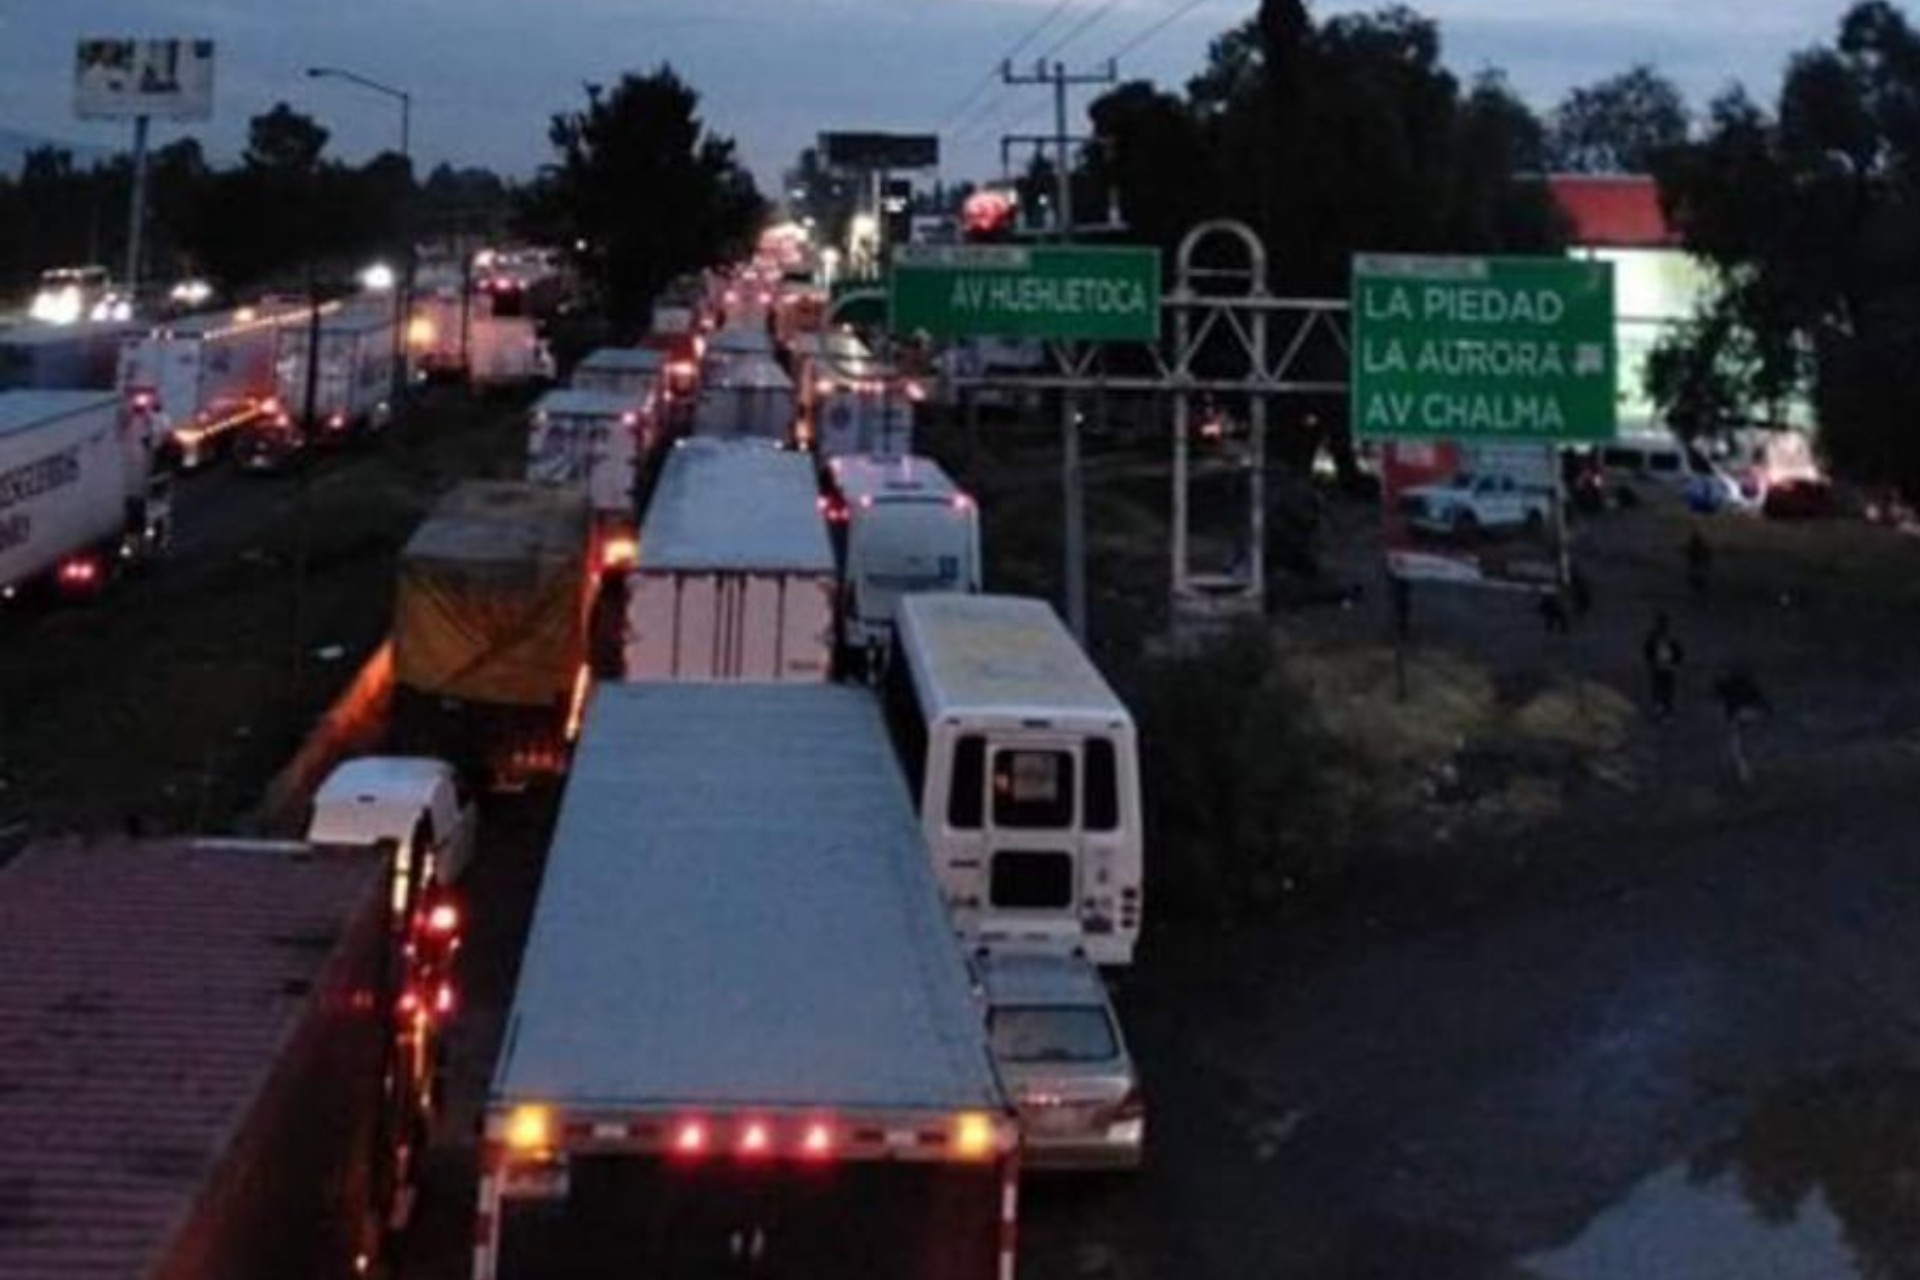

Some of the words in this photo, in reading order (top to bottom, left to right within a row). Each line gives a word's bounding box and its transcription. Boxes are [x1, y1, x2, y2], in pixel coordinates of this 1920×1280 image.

[952, 278, 983, 314] AV
[990, 279, 1147, 314] HUEHUETOCA
[1365, 286, 1413, 320] LA
[1424, 289, 1565, 324] PIEDAD
[1363, 339, 1407, 374] LA
[1416, 340, 1566, 376] AURORA
[1364, 394, 1412, 427] AV
[1421, 395, 1566, 430] CHALMA
